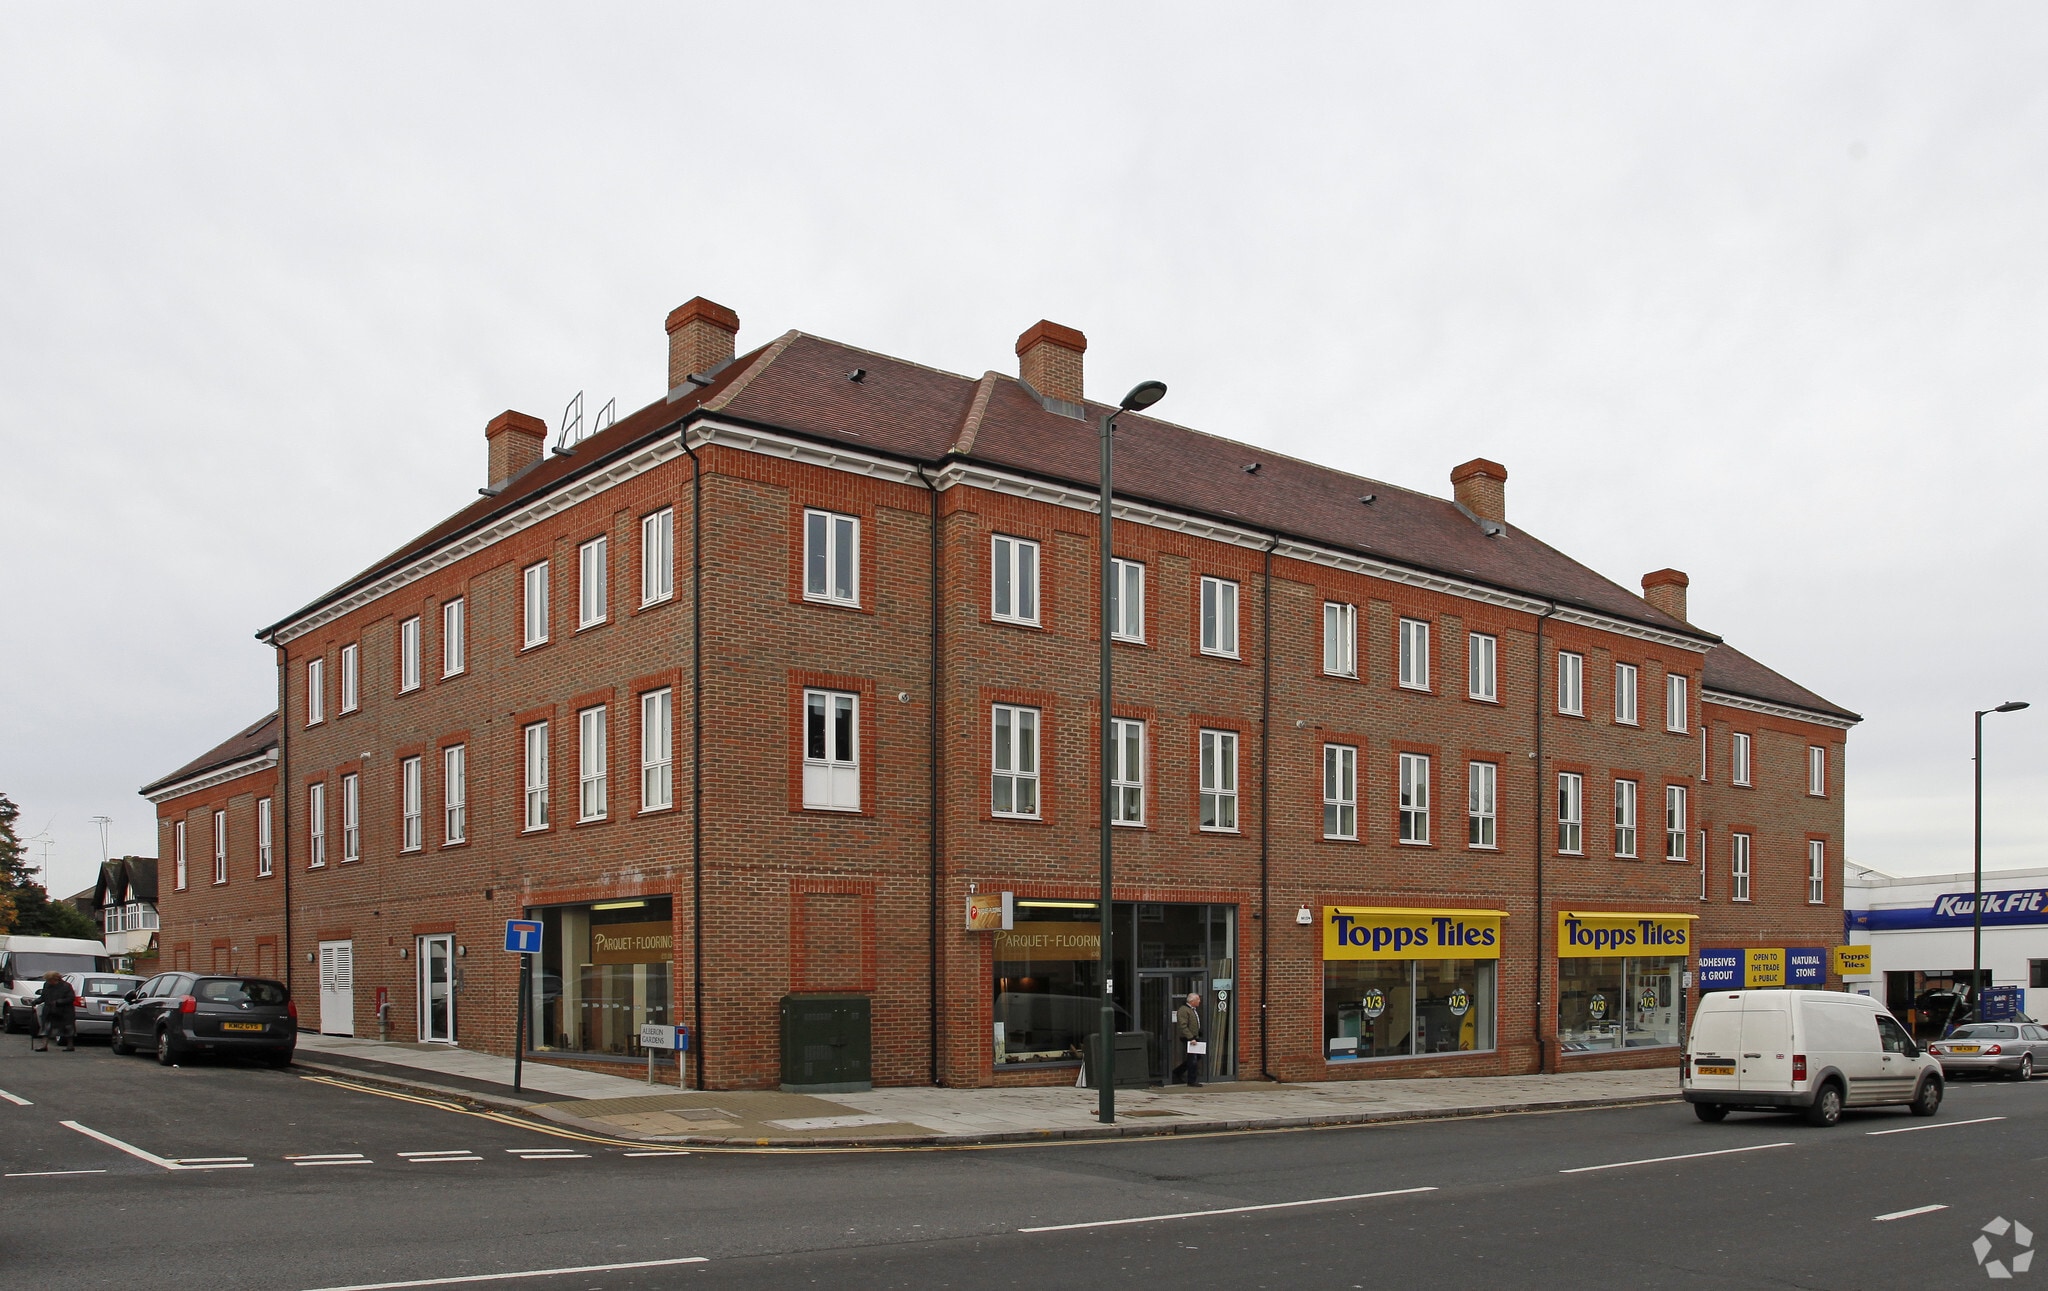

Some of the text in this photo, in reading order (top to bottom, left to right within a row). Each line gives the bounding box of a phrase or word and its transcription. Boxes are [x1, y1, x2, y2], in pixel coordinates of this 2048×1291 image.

[1936, 892, 2042, 916] Kwik Fit
[1331, 915, 1495, 951] Topps Tiles
[1564, 919, 1686, 950] Topps Tiles
[993, 930, 1101, 949] PARQUET-FLOORIN
[1753, 953, 1769, 961] OPEN
[1791, 956, 1820, 965] NATURAL
[1839, 952, 1869, 960] Topps
[1699, 957, 1736, 967] ADHESIVES
[1751, 964, 1762, 972] THE
[1796, 968, 1816, 978] STONE
[1700, 972, 1707, 981] &
[1708, 970, 1733, 980] GROUT
[1753, 974, 1778, 983] & PUBLIC
[1366, 995, 1382, 1009] 1/3
[1451, 995, 1466, 1008] 1/3
[1593, 1001, 1605, 1012] 1/3
[1643, 997, 1654, 1007] 1/3
[642, 1028, 664, 1036] ALBERON
[641, 1036, 664, 1045] GARDENS
